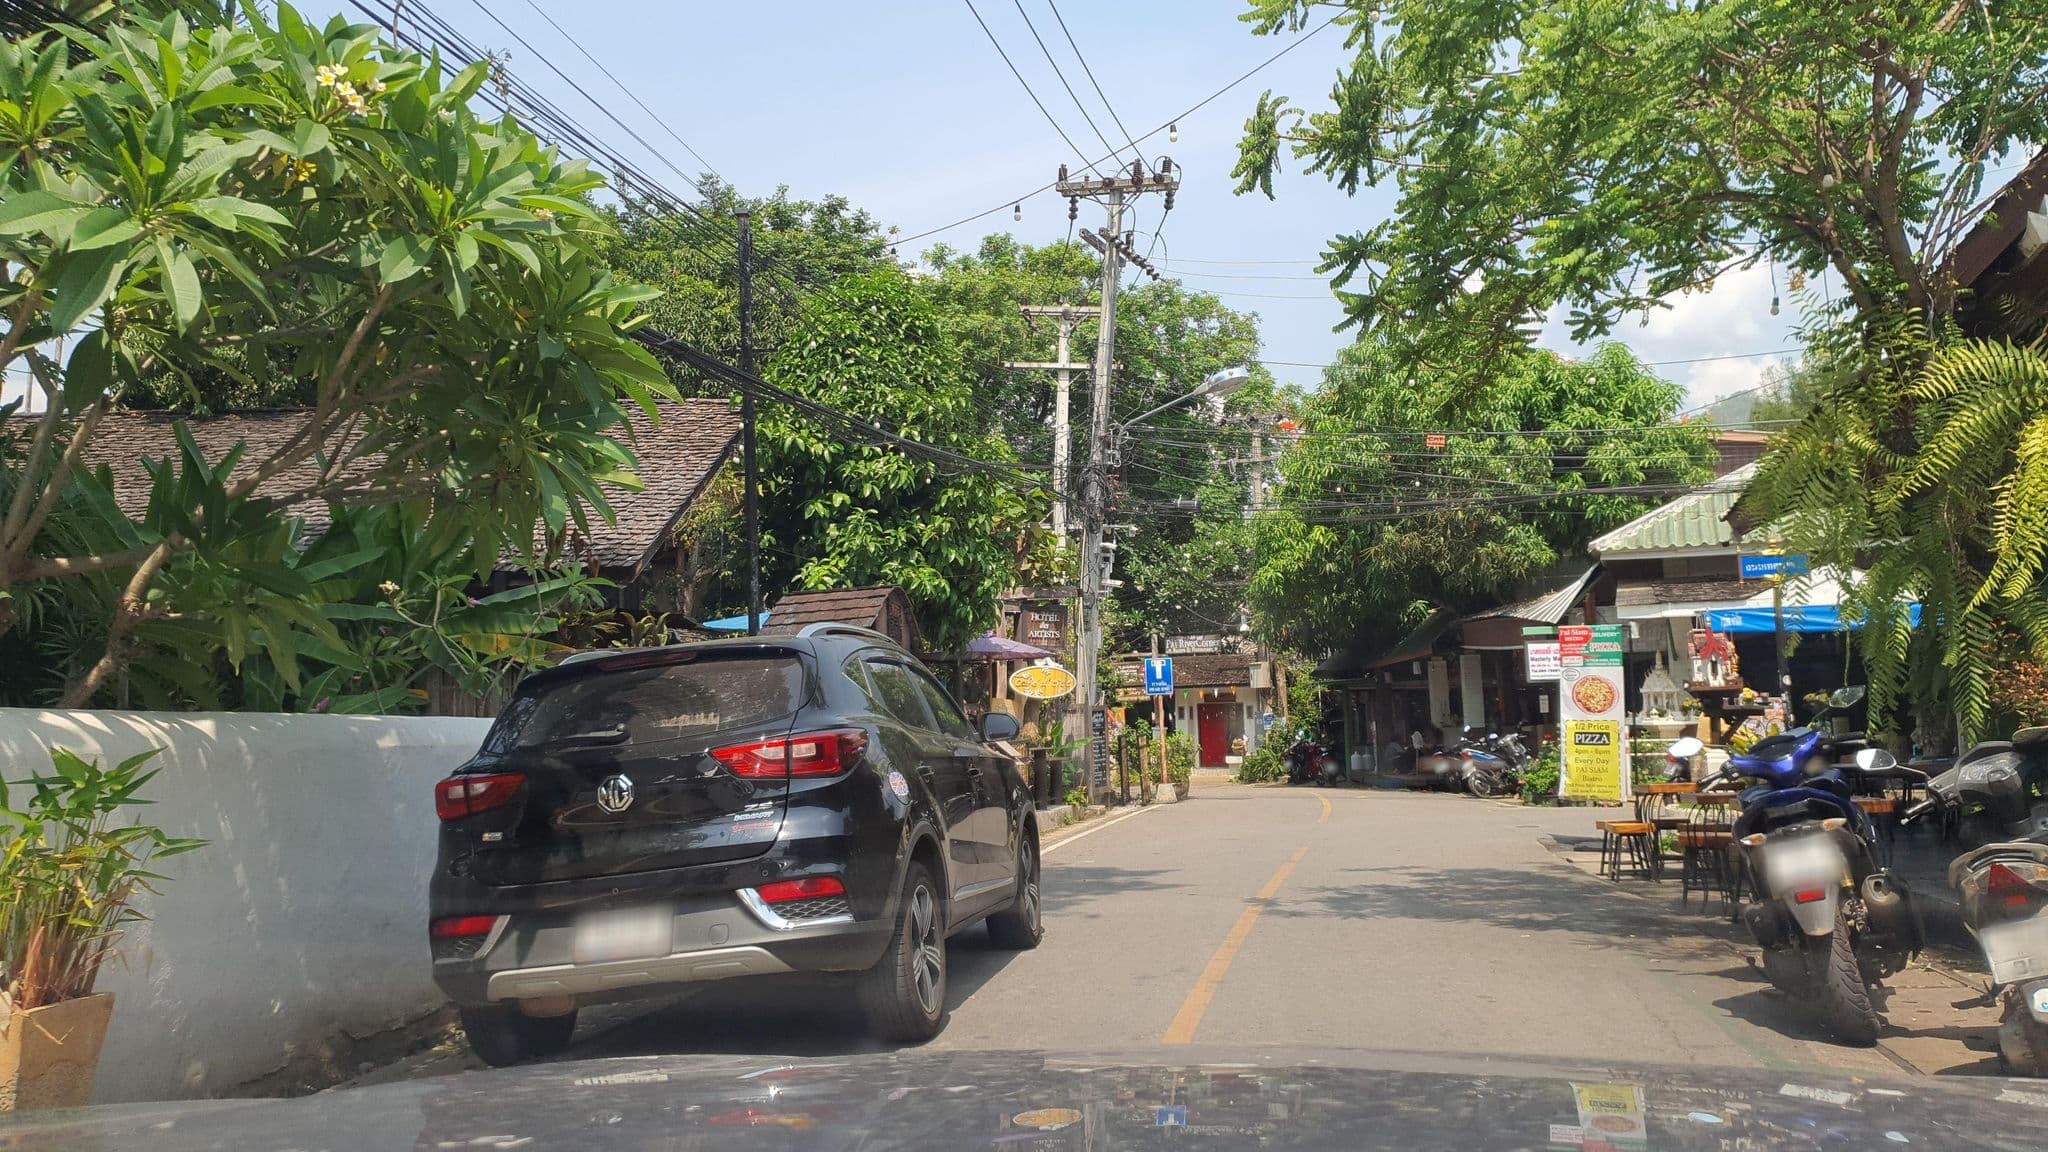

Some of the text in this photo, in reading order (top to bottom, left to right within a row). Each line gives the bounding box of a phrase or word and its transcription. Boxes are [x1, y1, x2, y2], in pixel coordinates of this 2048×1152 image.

[1029, 630, 1060, 638] ARTISTS
[1590, 642, 1621, 652] PIZZA
[1576, 734, 1609, 744] PIZZA
[599, 777, 630, 810] MG
